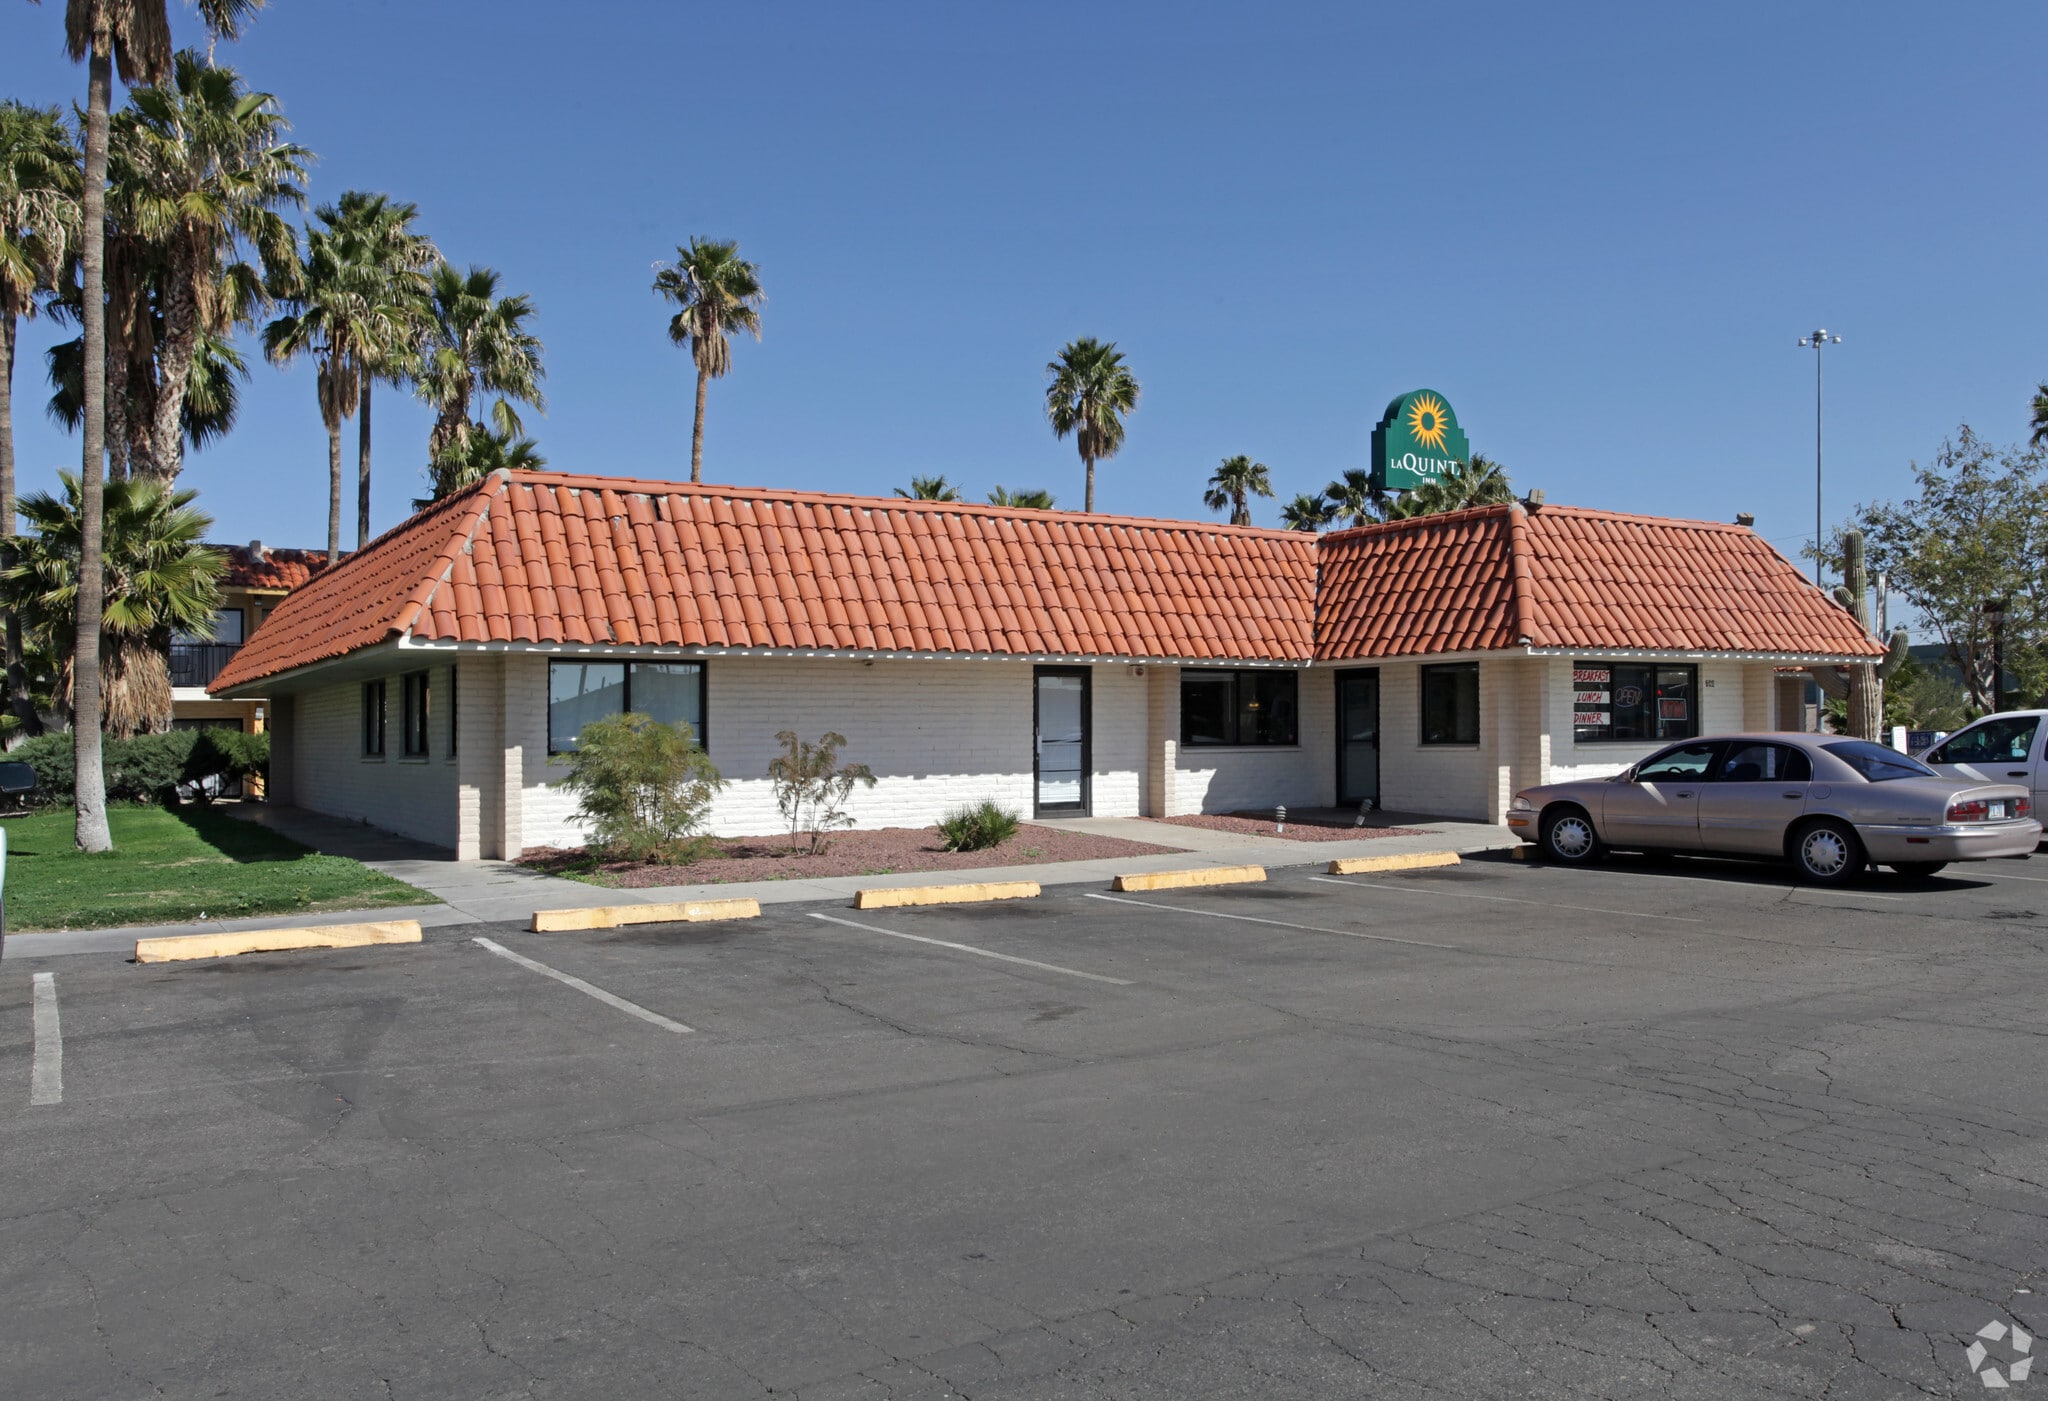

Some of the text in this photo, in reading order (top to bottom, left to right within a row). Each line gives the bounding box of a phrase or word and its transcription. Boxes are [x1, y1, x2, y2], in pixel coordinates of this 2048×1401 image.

[1403, 452, 1461, 476] QUINT
[1573, 670, 1611, 682] BREAKFAST
[1576, 692, 1603, 702] LUNCH
[1615, 688, 1642, 705] OPEN
[1574, 712, 1604, 724] DINNER
